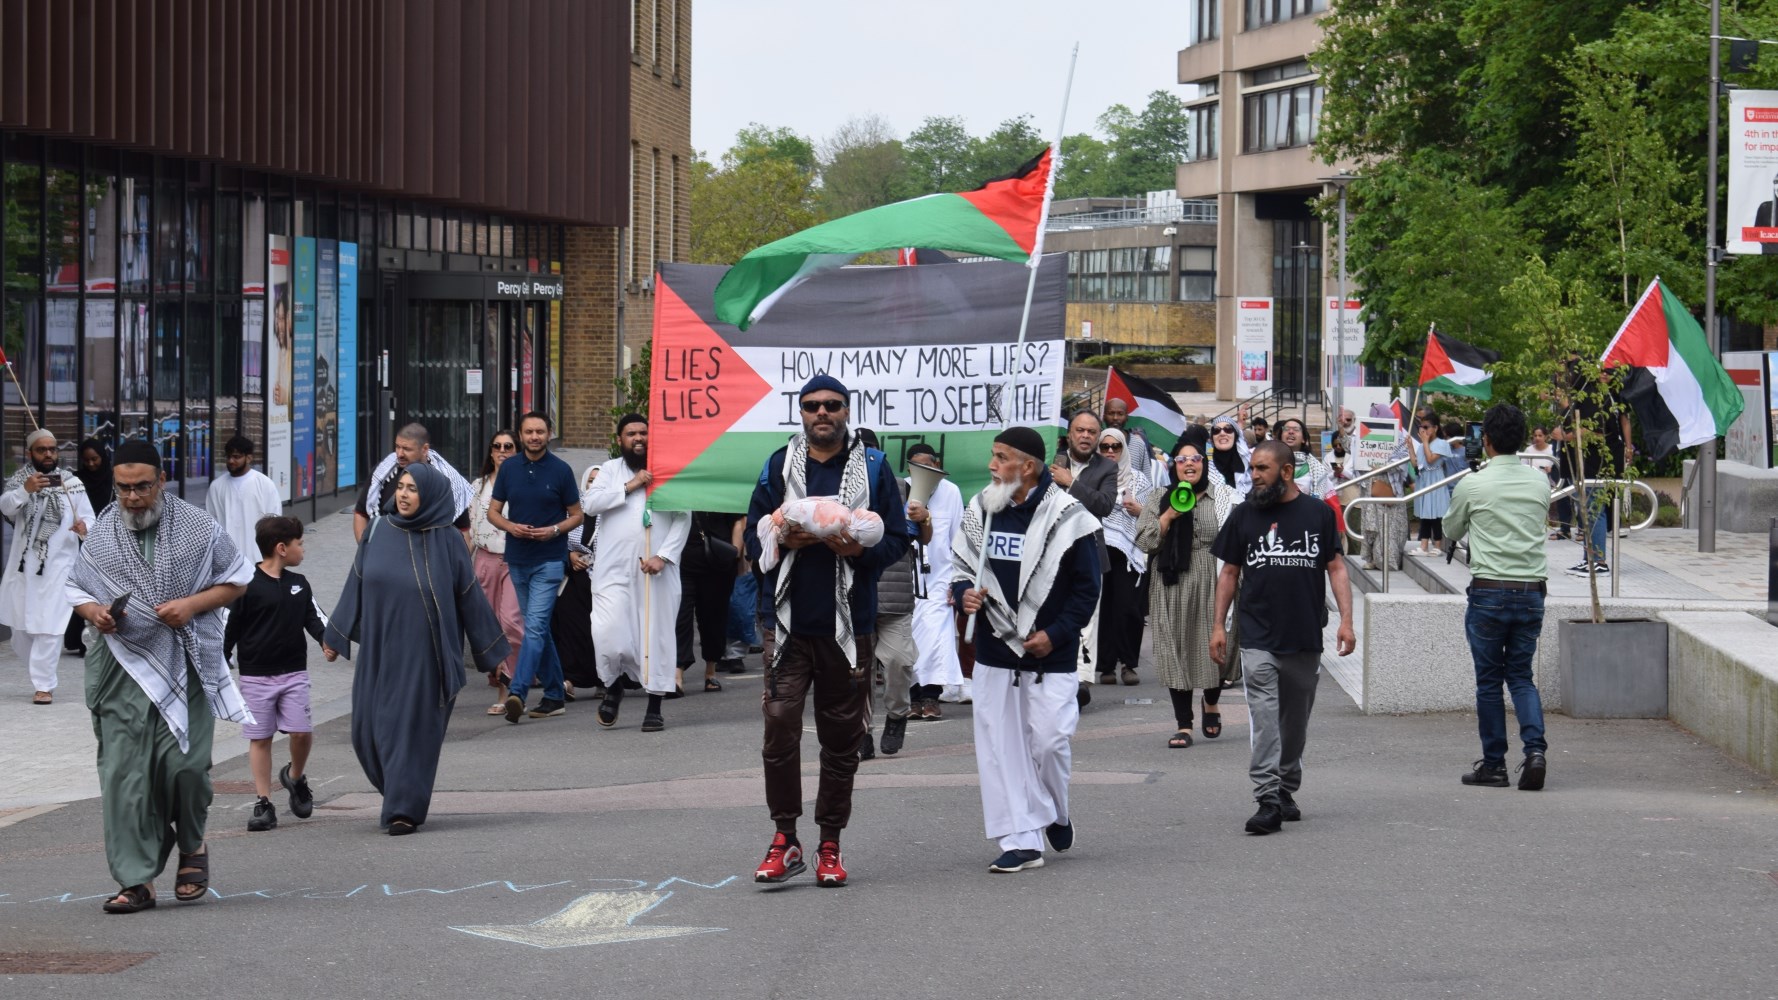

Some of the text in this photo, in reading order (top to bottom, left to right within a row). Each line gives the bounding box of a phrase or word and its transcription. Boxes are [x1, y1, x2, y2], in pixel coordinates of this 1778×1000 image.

[1744, 129, 1759, 138] 4th
[1761, 129, 1769, 138] in
[1744, 142, 1757, 151] for
[498, 281, 521, 298] Percy
[533, 282, 555, 298] Percy
[664, 346, 723, 381] LIES
[781, 342, 1050, 383] HOW MANY MORE LIES?
[662, 385, 721, 421] LIES
[905, 387, 938, 426] TO
[1009, 383, 1052, 423] THE
[1360, 440, 1395, 450] Stop Killin
[986, 534, 1025, 557] PRE
[1269, 557, 1317, 568] PALESTINE
